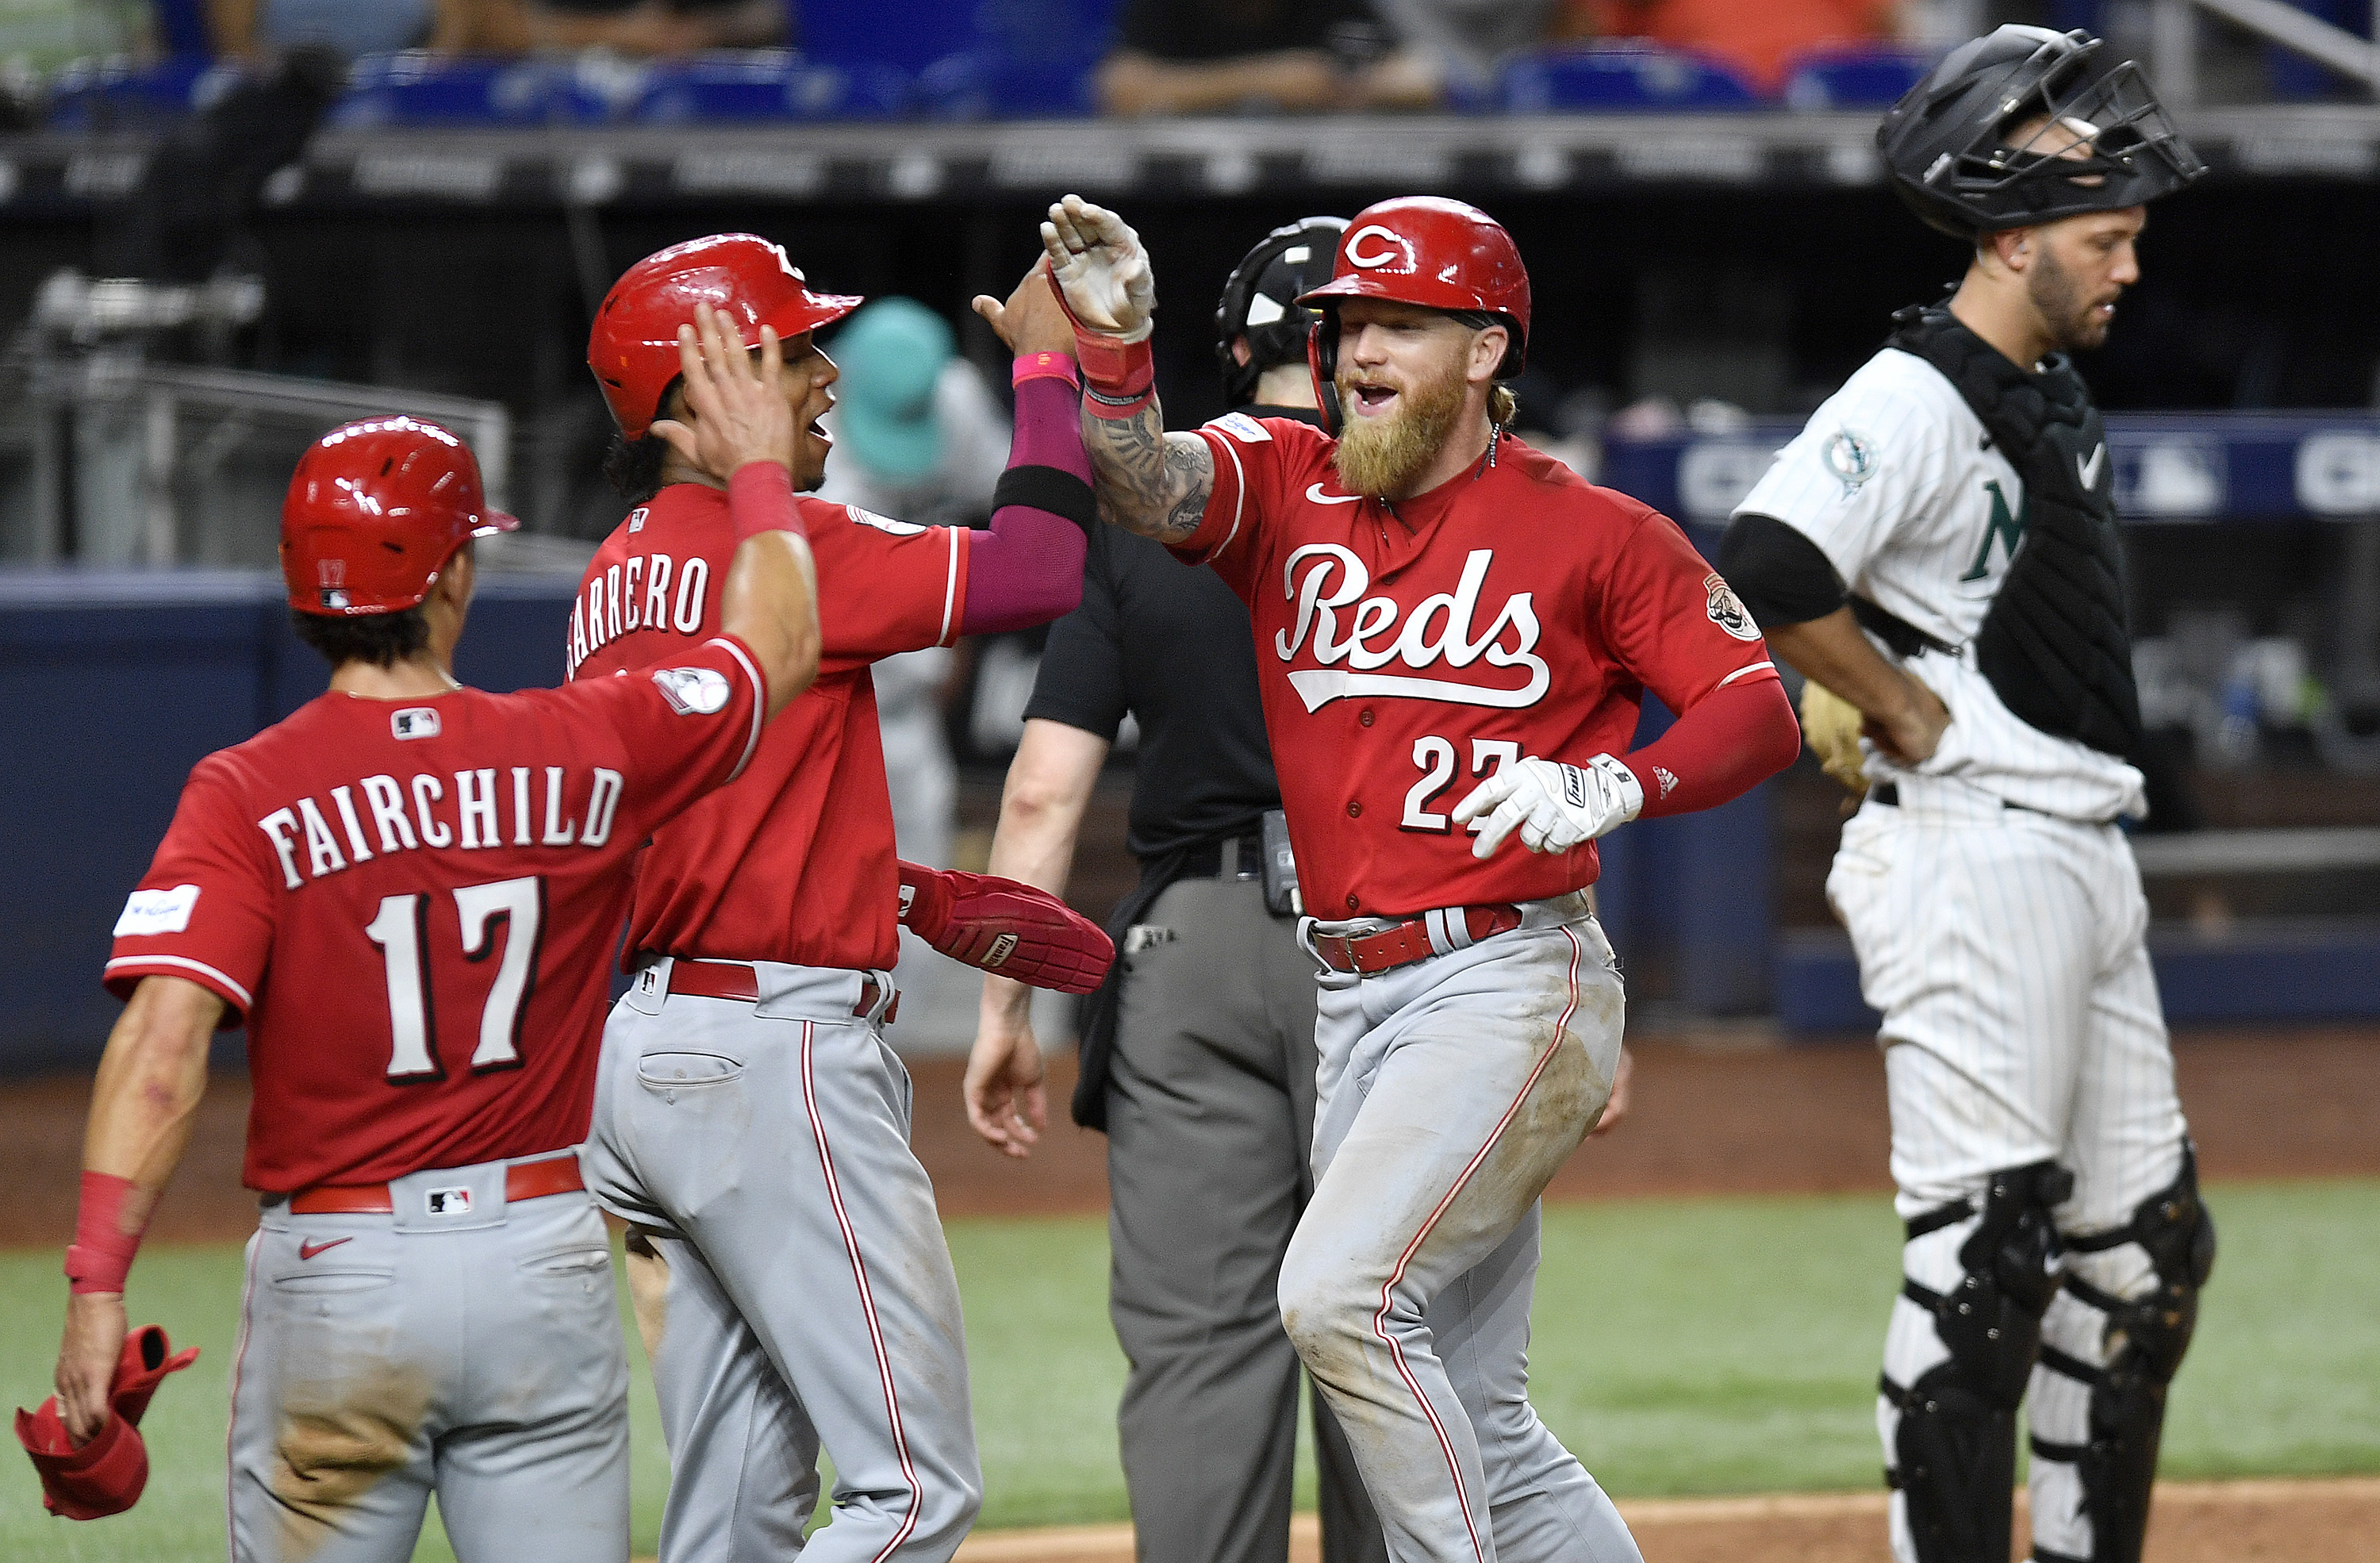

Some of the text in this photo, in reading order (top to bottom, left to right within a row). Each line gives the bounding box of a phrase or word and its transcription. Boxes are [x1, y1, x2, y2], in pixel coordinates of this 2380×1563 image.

[1345, 225, 1398, 268] C
[1276, 543, 1549, 712] Reds
[259, 766, 624, 890] FAIRCHILD
[366, 876, 548, 1085] 17
